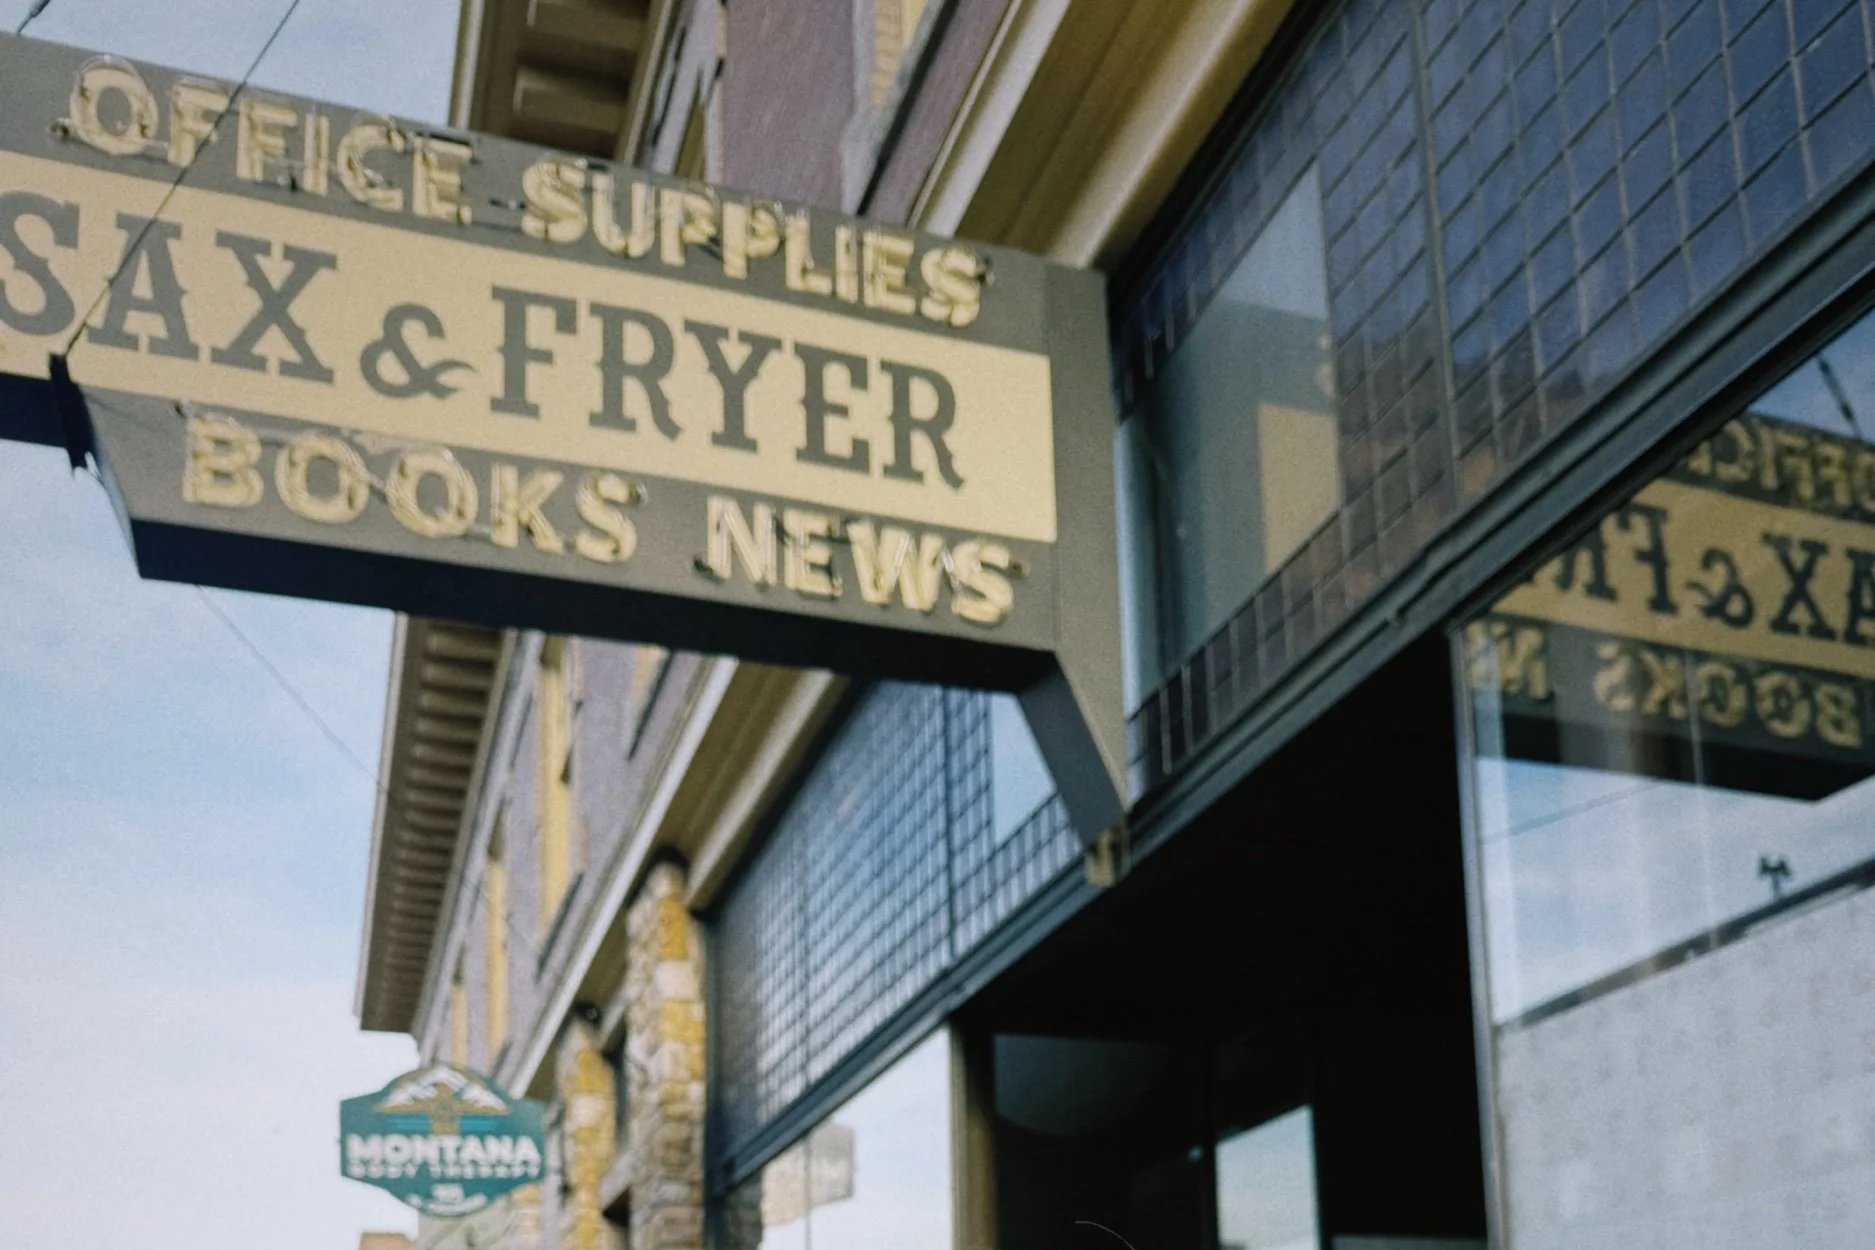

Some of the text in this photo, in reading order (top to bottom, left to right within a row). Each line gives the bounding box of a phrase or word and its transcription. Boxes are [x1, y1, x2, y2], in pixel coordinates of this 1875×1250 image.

[68, 54, 982, 327] OFFICE SUPPLIES
[0, 190, 965, 491] SAX & FRYER
[182, 413, 1016, 626] BOOKS NEWS
[347, 1133, 541, 1165] MONTANA
